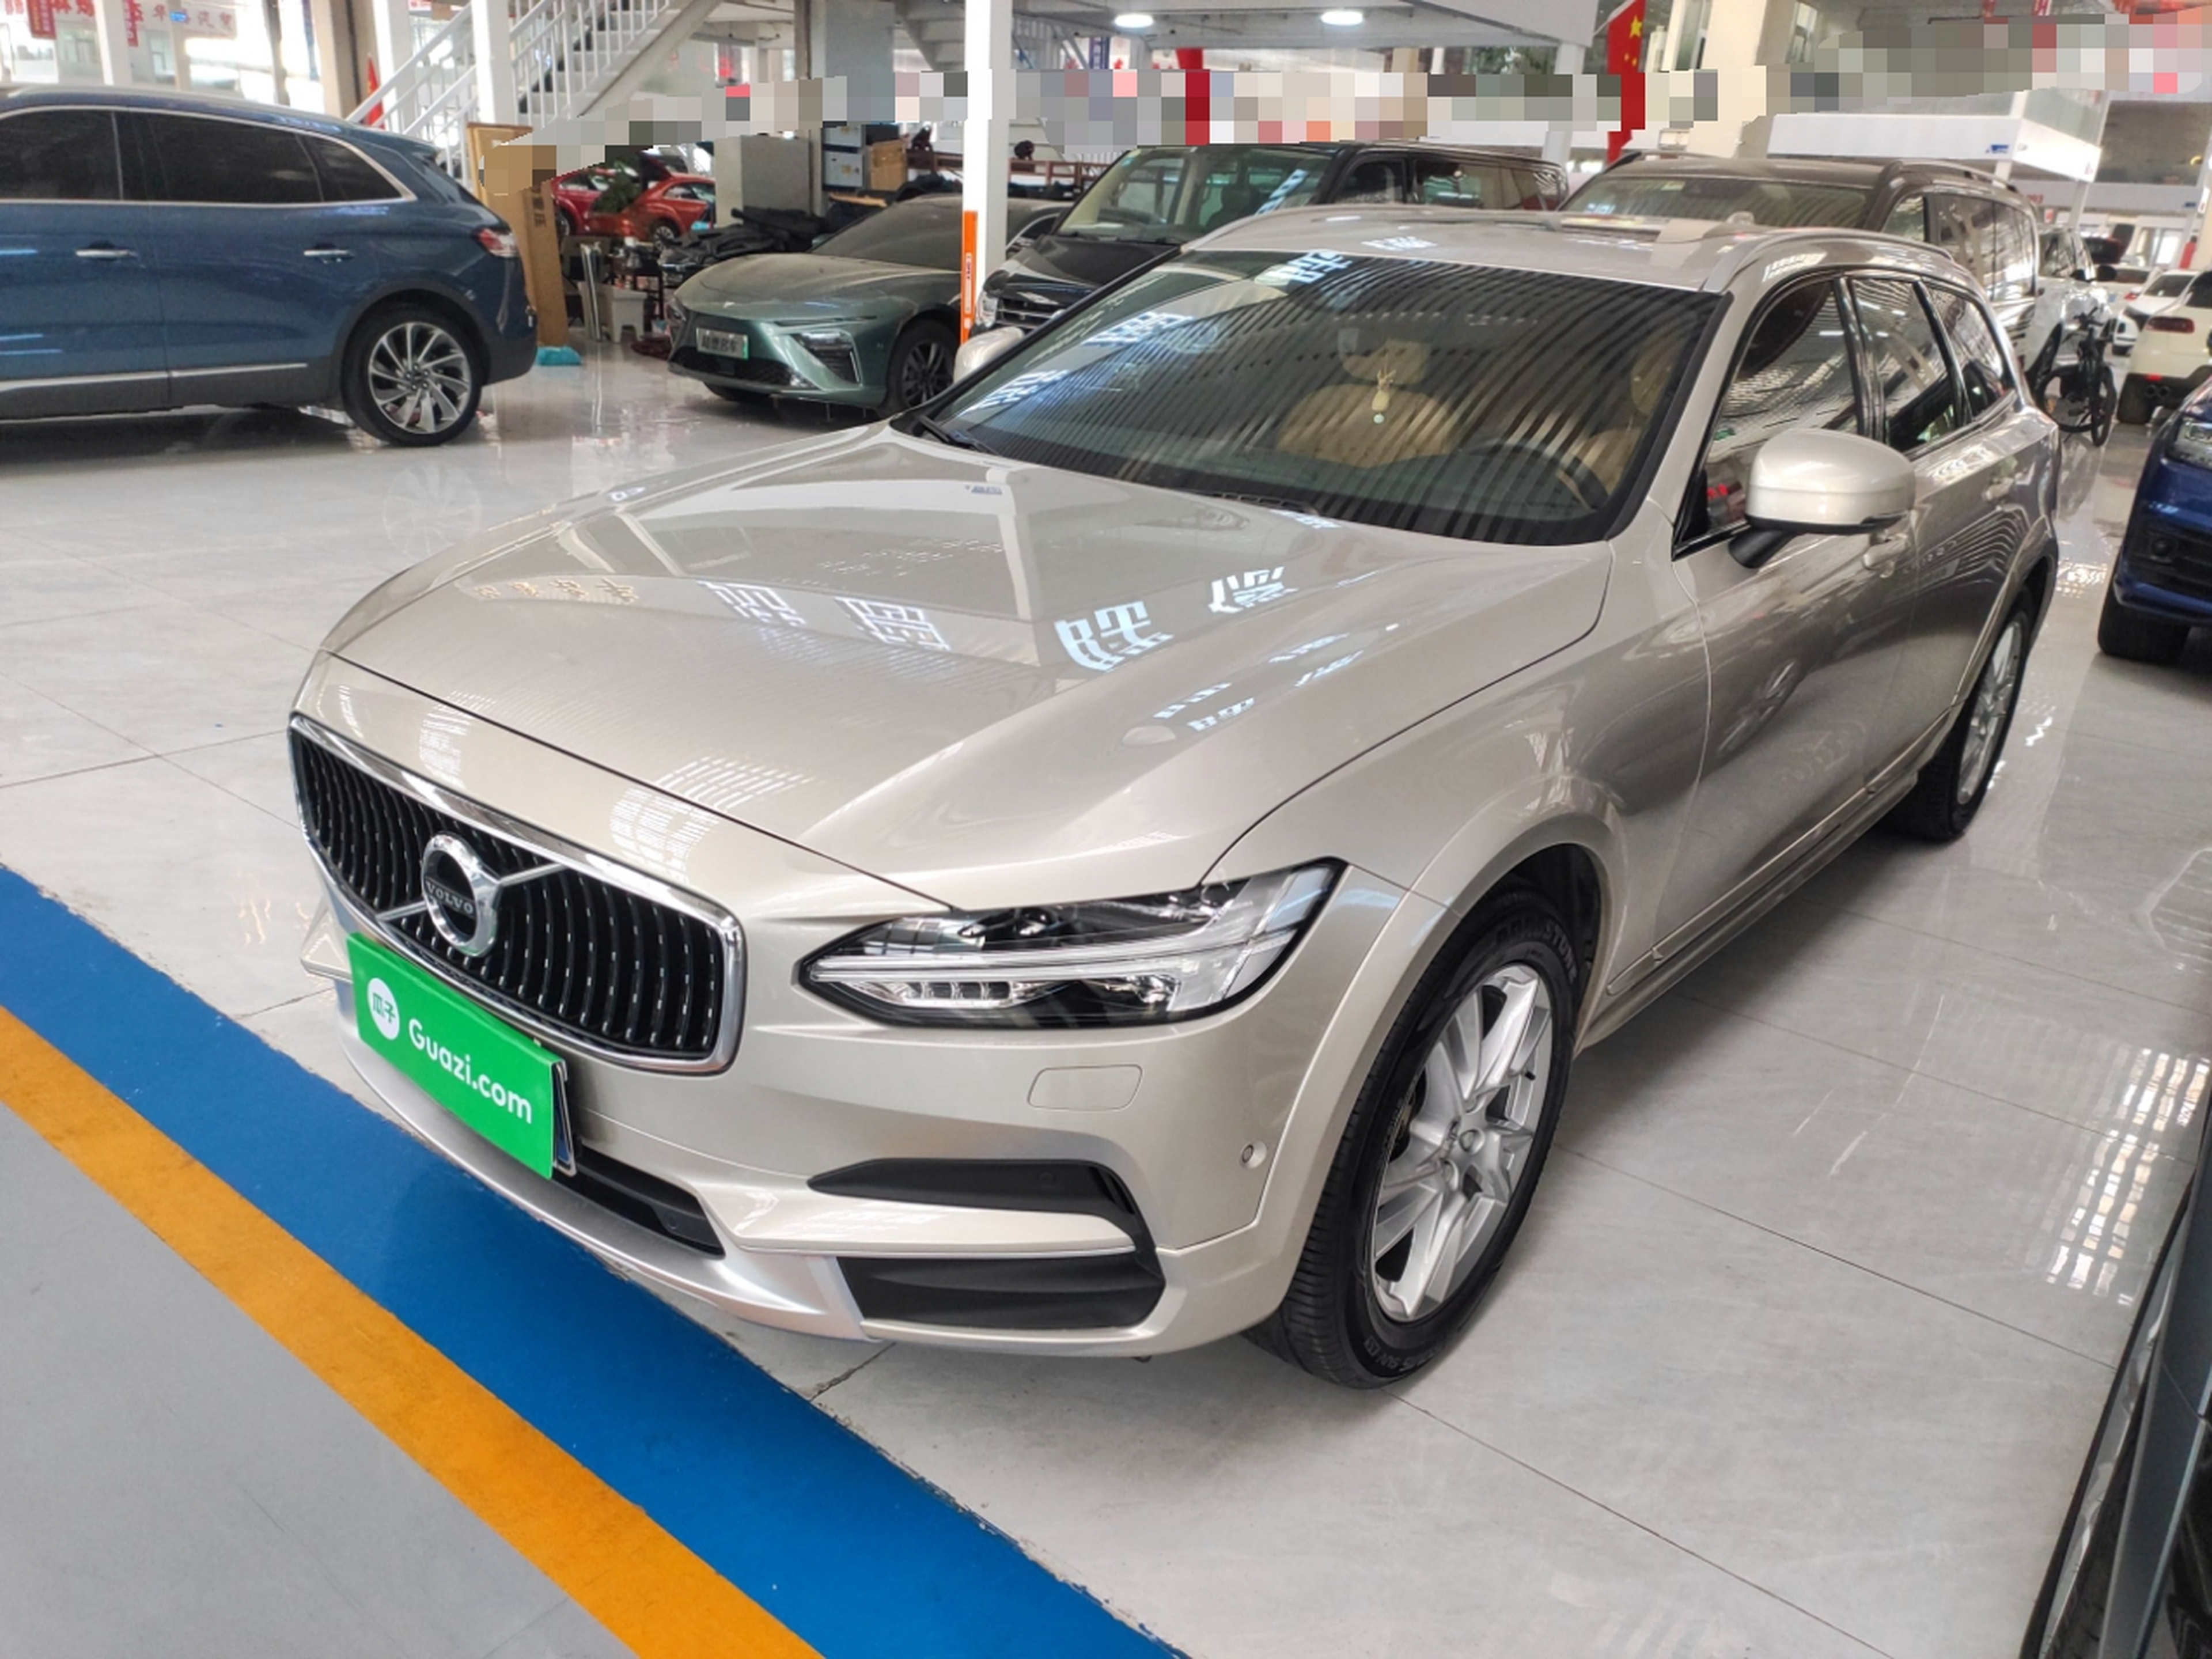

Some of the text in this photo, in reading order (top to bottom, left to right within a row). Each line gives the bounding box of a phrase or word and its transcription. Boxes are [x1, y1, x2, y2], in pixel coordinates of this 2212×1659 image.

[426, 880, 474, 914] VOLVO
[373, 992, 396, 1024] 瓜子
[408, 1018, 532, 1124] Guazi.com
